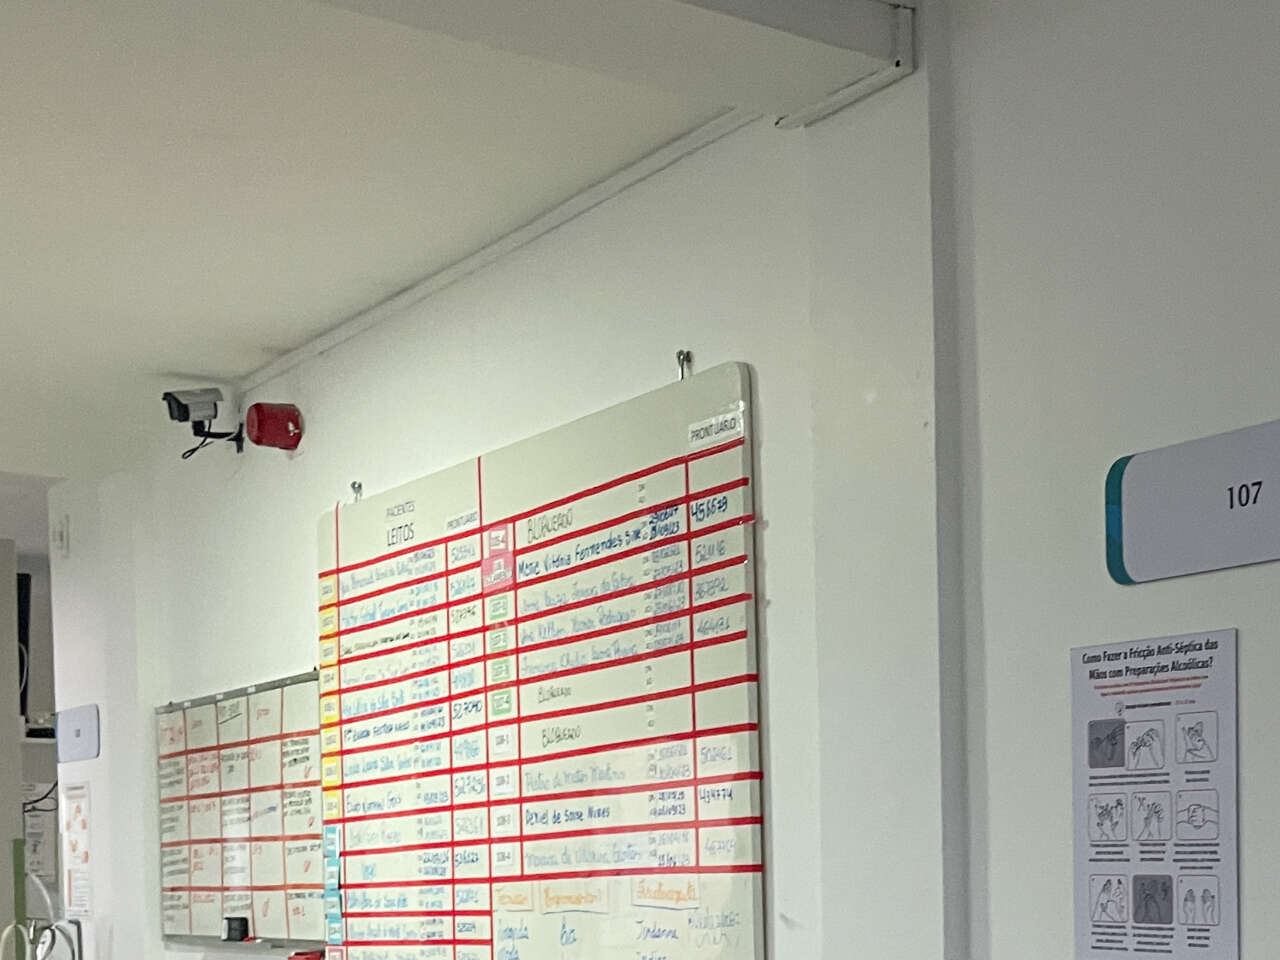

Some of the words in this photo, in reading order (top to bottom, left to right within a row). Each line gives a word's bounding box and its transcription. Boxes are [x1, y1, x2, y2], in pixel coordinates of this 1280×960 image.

[1227, 481, 1263, 509] 107
[387, 523, 415, 547] LEITOS
[1082, 652, 1101, 665] Como
[1103, 650, 1122, 662] Fazer
[1129, 646, 1155, 660] Fricção
[1156, 640, 1203, 657] Anti-Séptica
[1204, 638, 1218, 651] das
[1089, 669, 1107, 681] Mãos
[1108, 667, 1124, 679] com
[1125, 663, 1170, 677] Preparações
